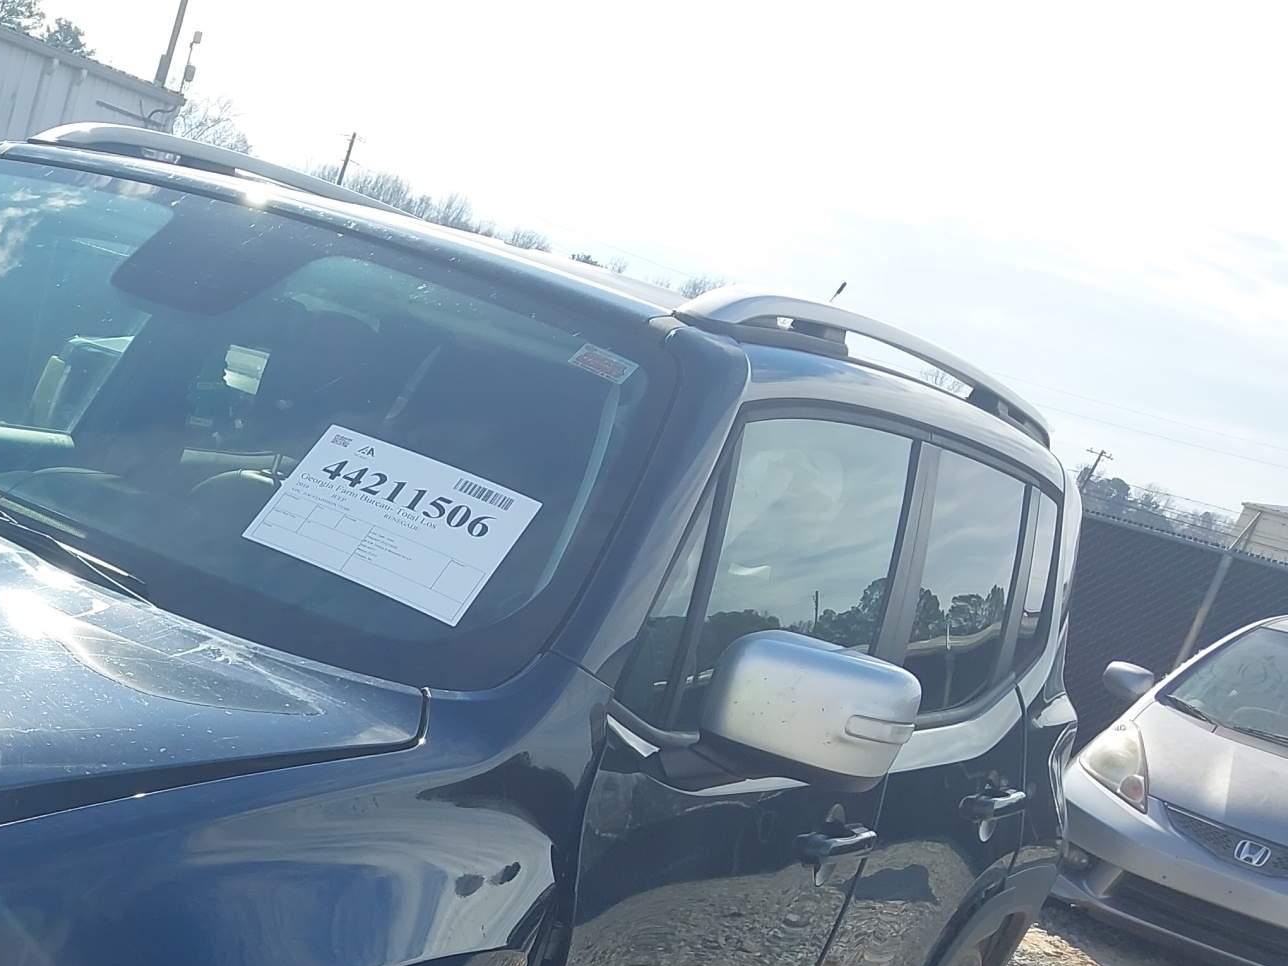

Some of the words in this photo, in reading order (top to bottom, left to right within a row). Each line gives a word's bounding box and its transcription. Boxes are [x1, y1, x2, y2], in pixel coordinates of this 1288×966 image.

[301, 473, 334, 489] Georgia
[335, 484, 358, 498] Farm
[397, 508, 420, 522] Total
[419, 517, 436, 529] Los
[322, 460, 497, 537] 44211506
